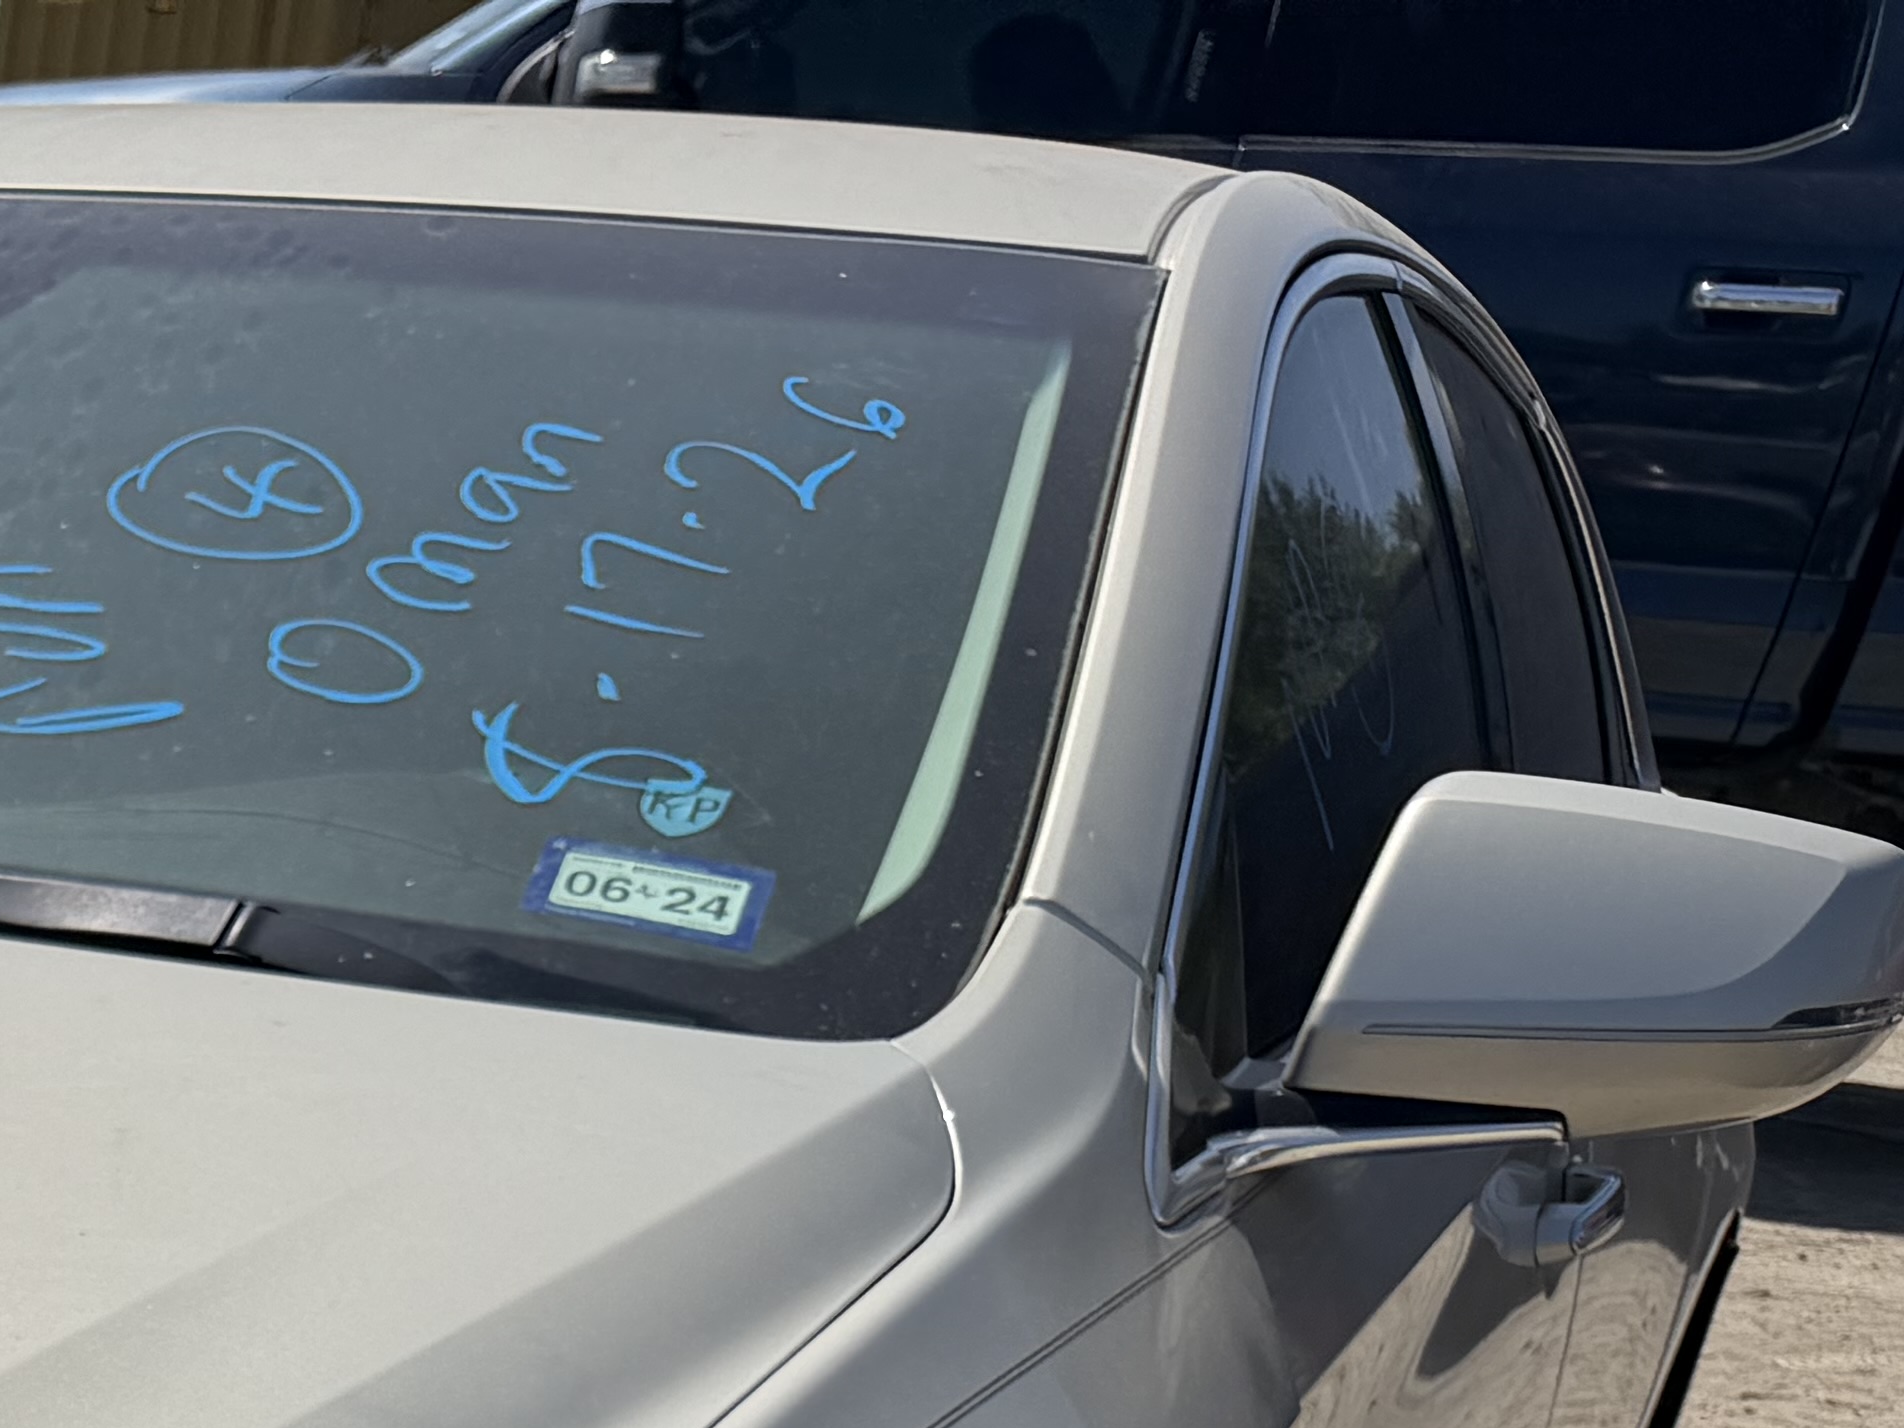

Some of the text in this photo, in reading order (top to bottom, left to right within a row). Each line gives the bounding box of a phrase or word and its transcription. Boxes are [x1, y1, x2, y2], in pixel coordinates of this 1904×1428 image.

[646, 790, 721, 824] KP
[563, 869, 633, 903] 06
[659, 886, 730, 922] 24
